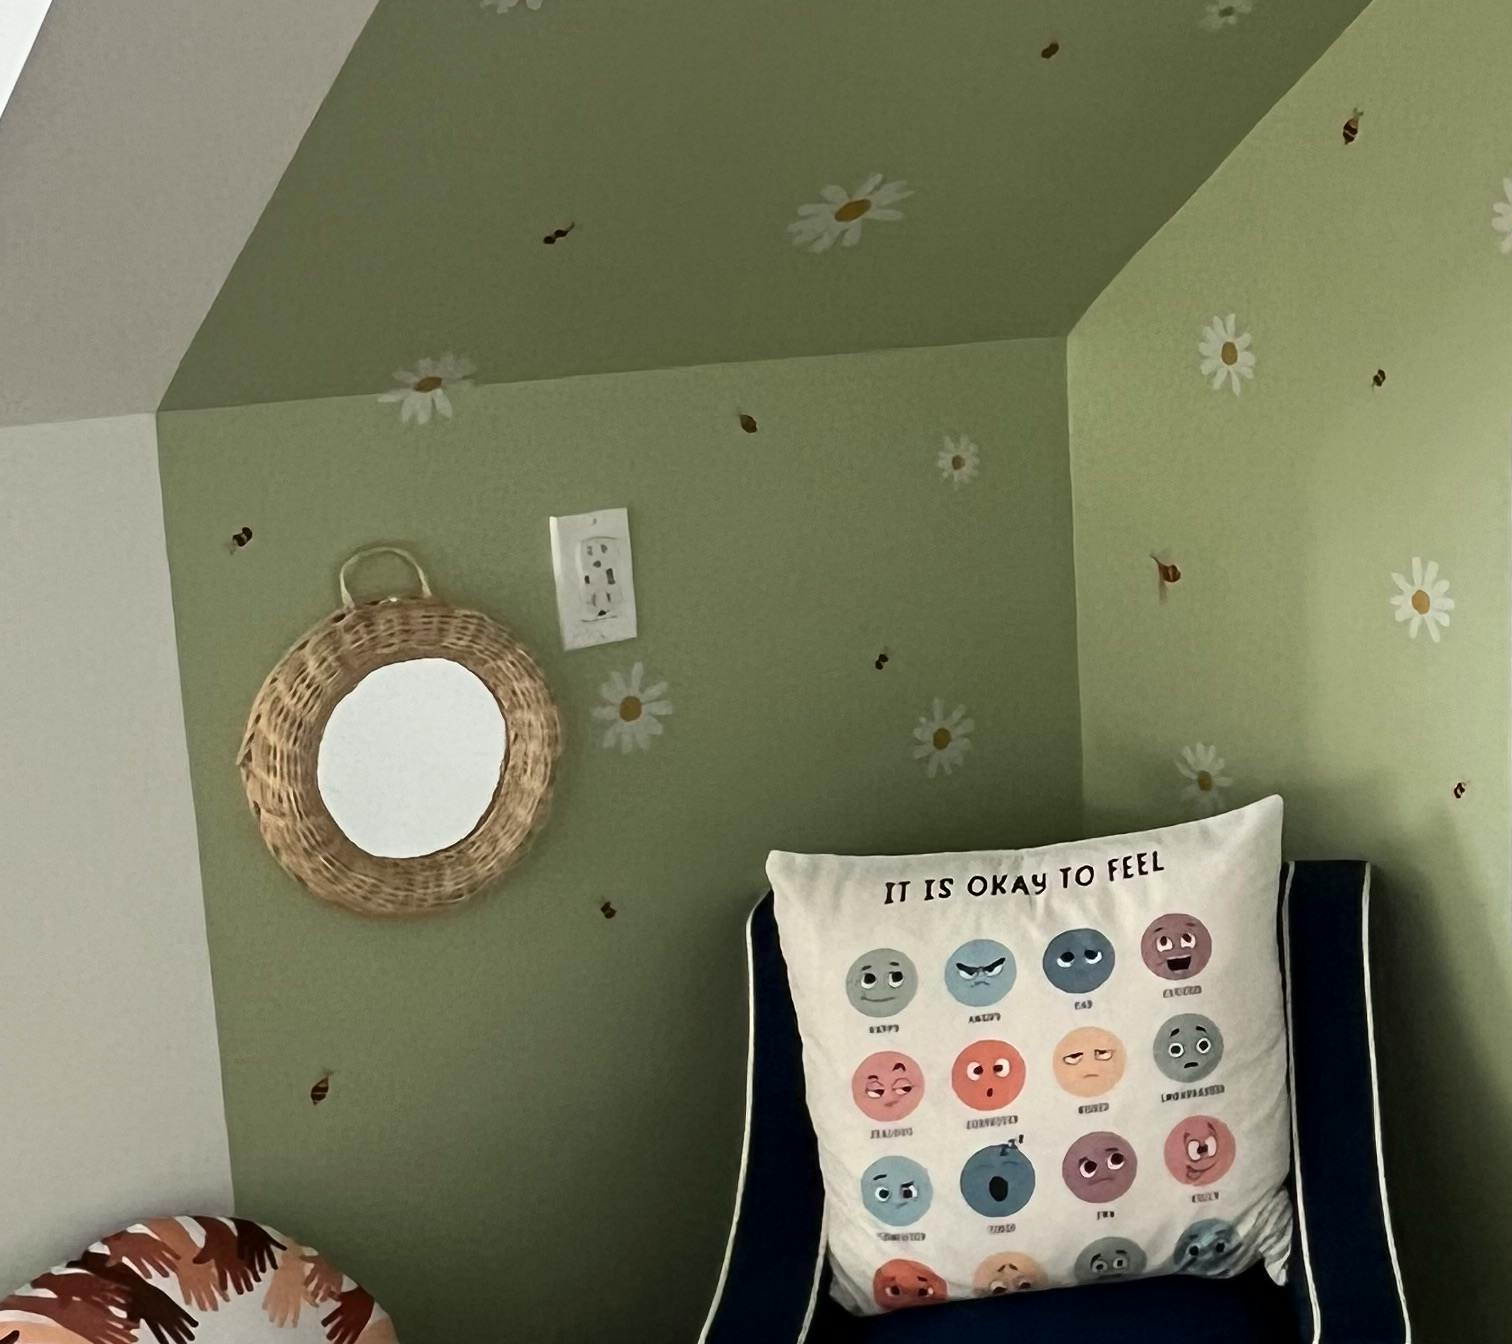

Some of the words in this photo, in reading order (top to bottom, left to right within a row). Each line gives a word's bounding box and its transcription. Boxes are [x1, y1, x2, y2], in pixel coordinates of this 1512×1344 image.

[884, 880, 911, 904] IT
[923, 877, 954, 901] IS
[967, 872, 1047, 896] OKAY
[1059, 864, 1095, 889] TO
[1107, 850, 1165, 882] FEEL
